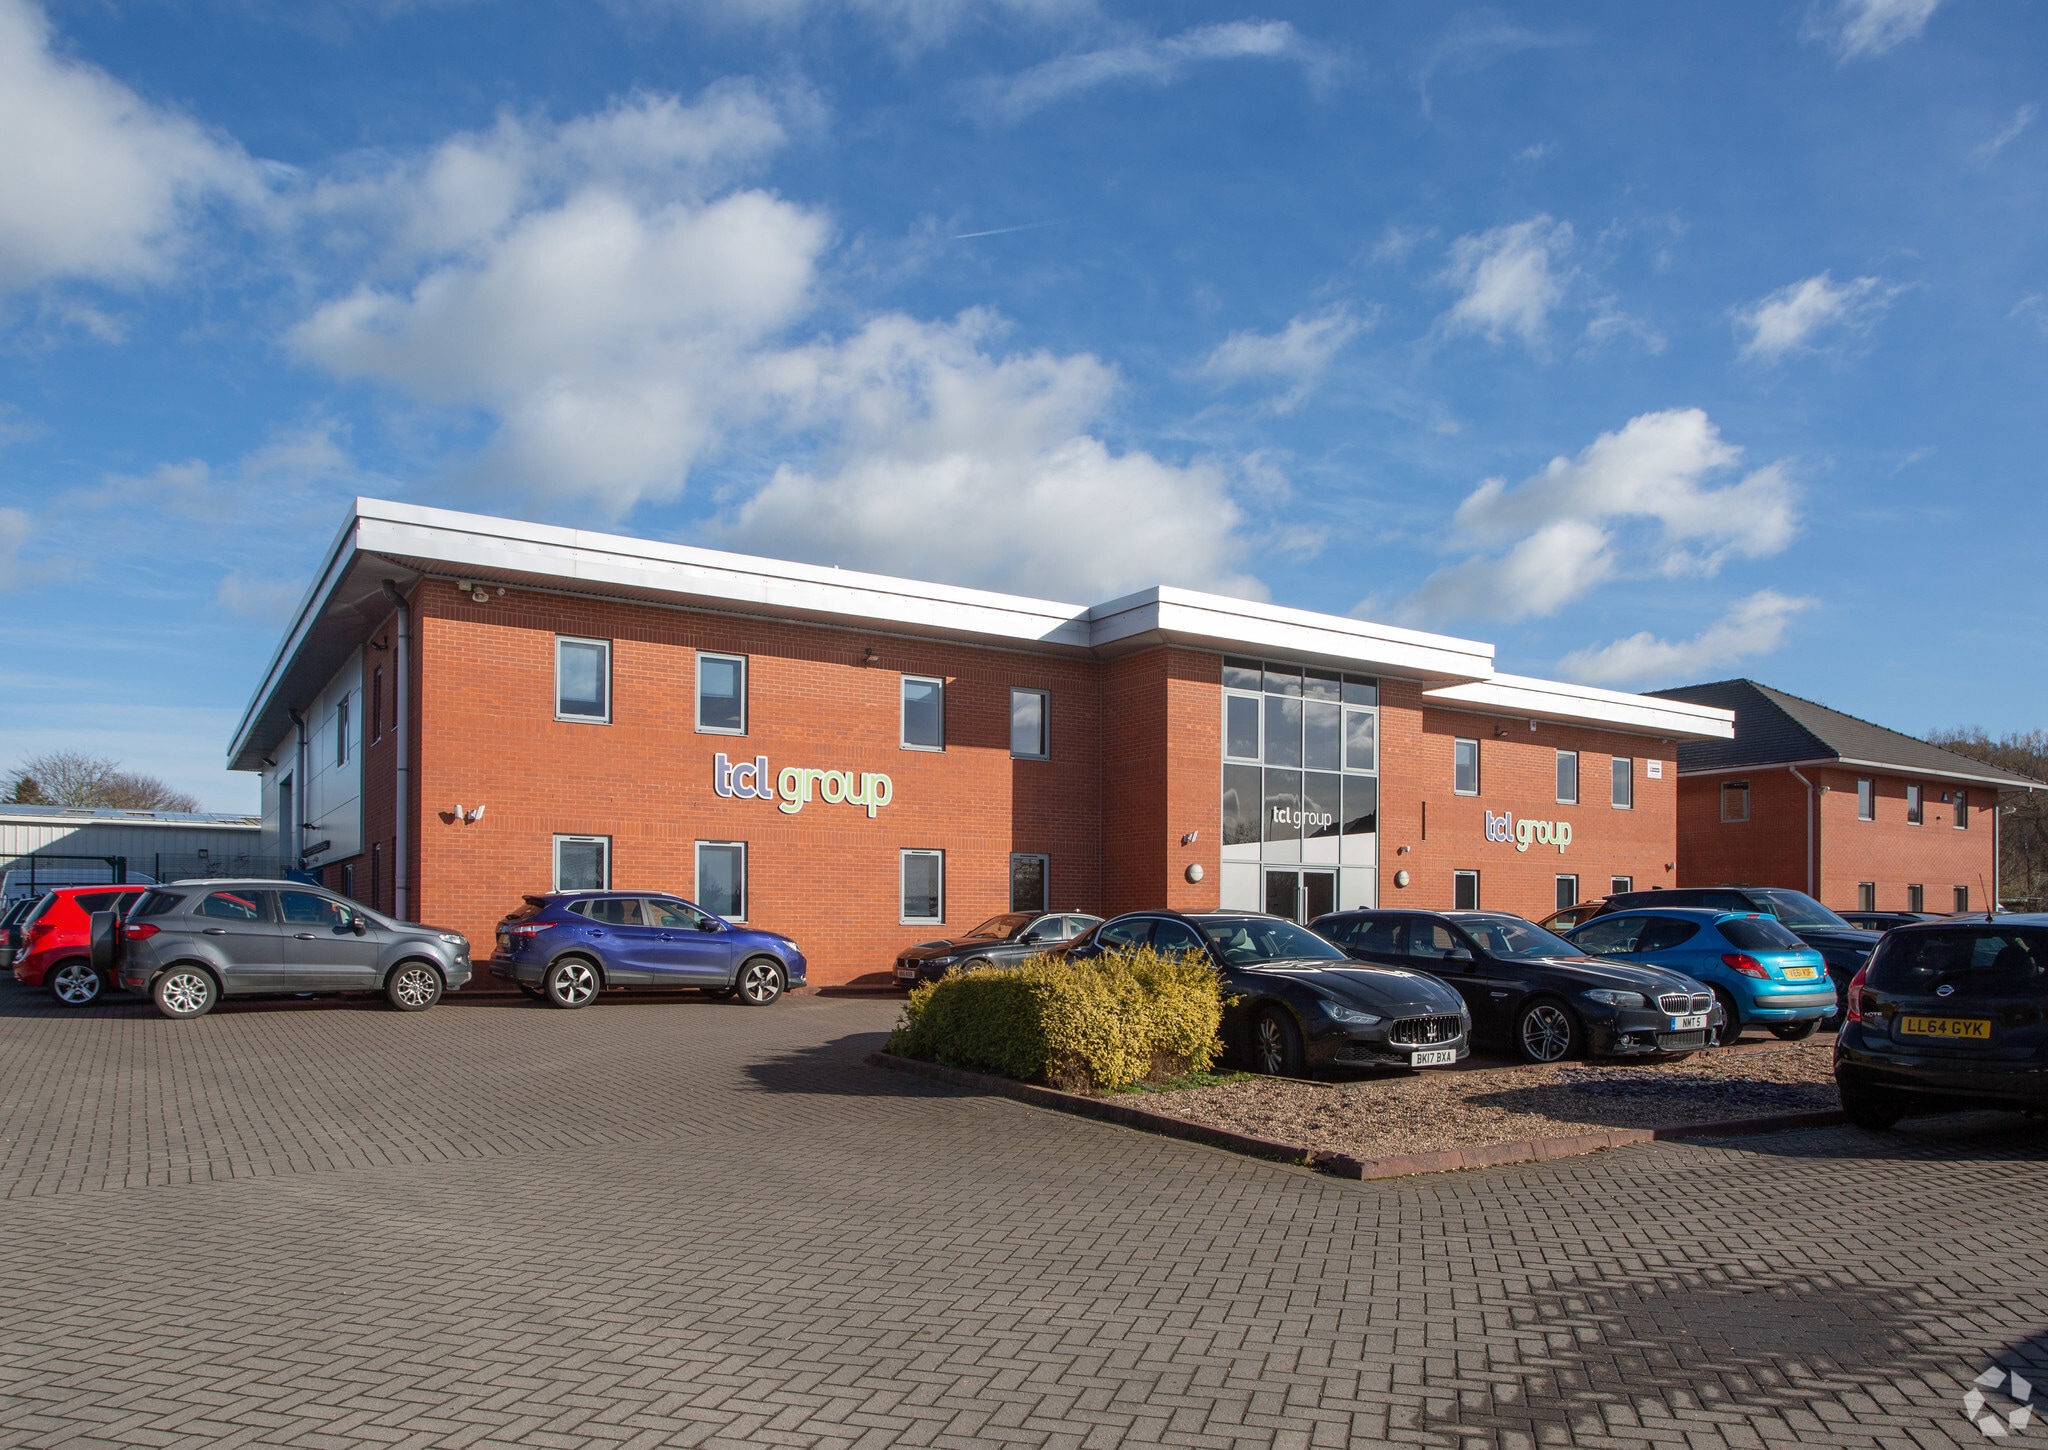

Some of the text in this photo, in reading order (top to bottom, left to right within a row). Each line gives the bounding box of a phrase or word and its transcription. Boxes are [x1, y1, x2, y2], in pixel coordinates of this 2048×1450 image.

[714, 753, 892, 818] tcl group
[1273, 806, 1332, 830] tcl group
[1485, 810, 1572, 854] tcl group
[1682, 1017, 1695, 1028] NMT
[1907, 1019, 1984, 1036] LL64 GYK
[1416, 1051, 1451, 1064] BK17 BXA
